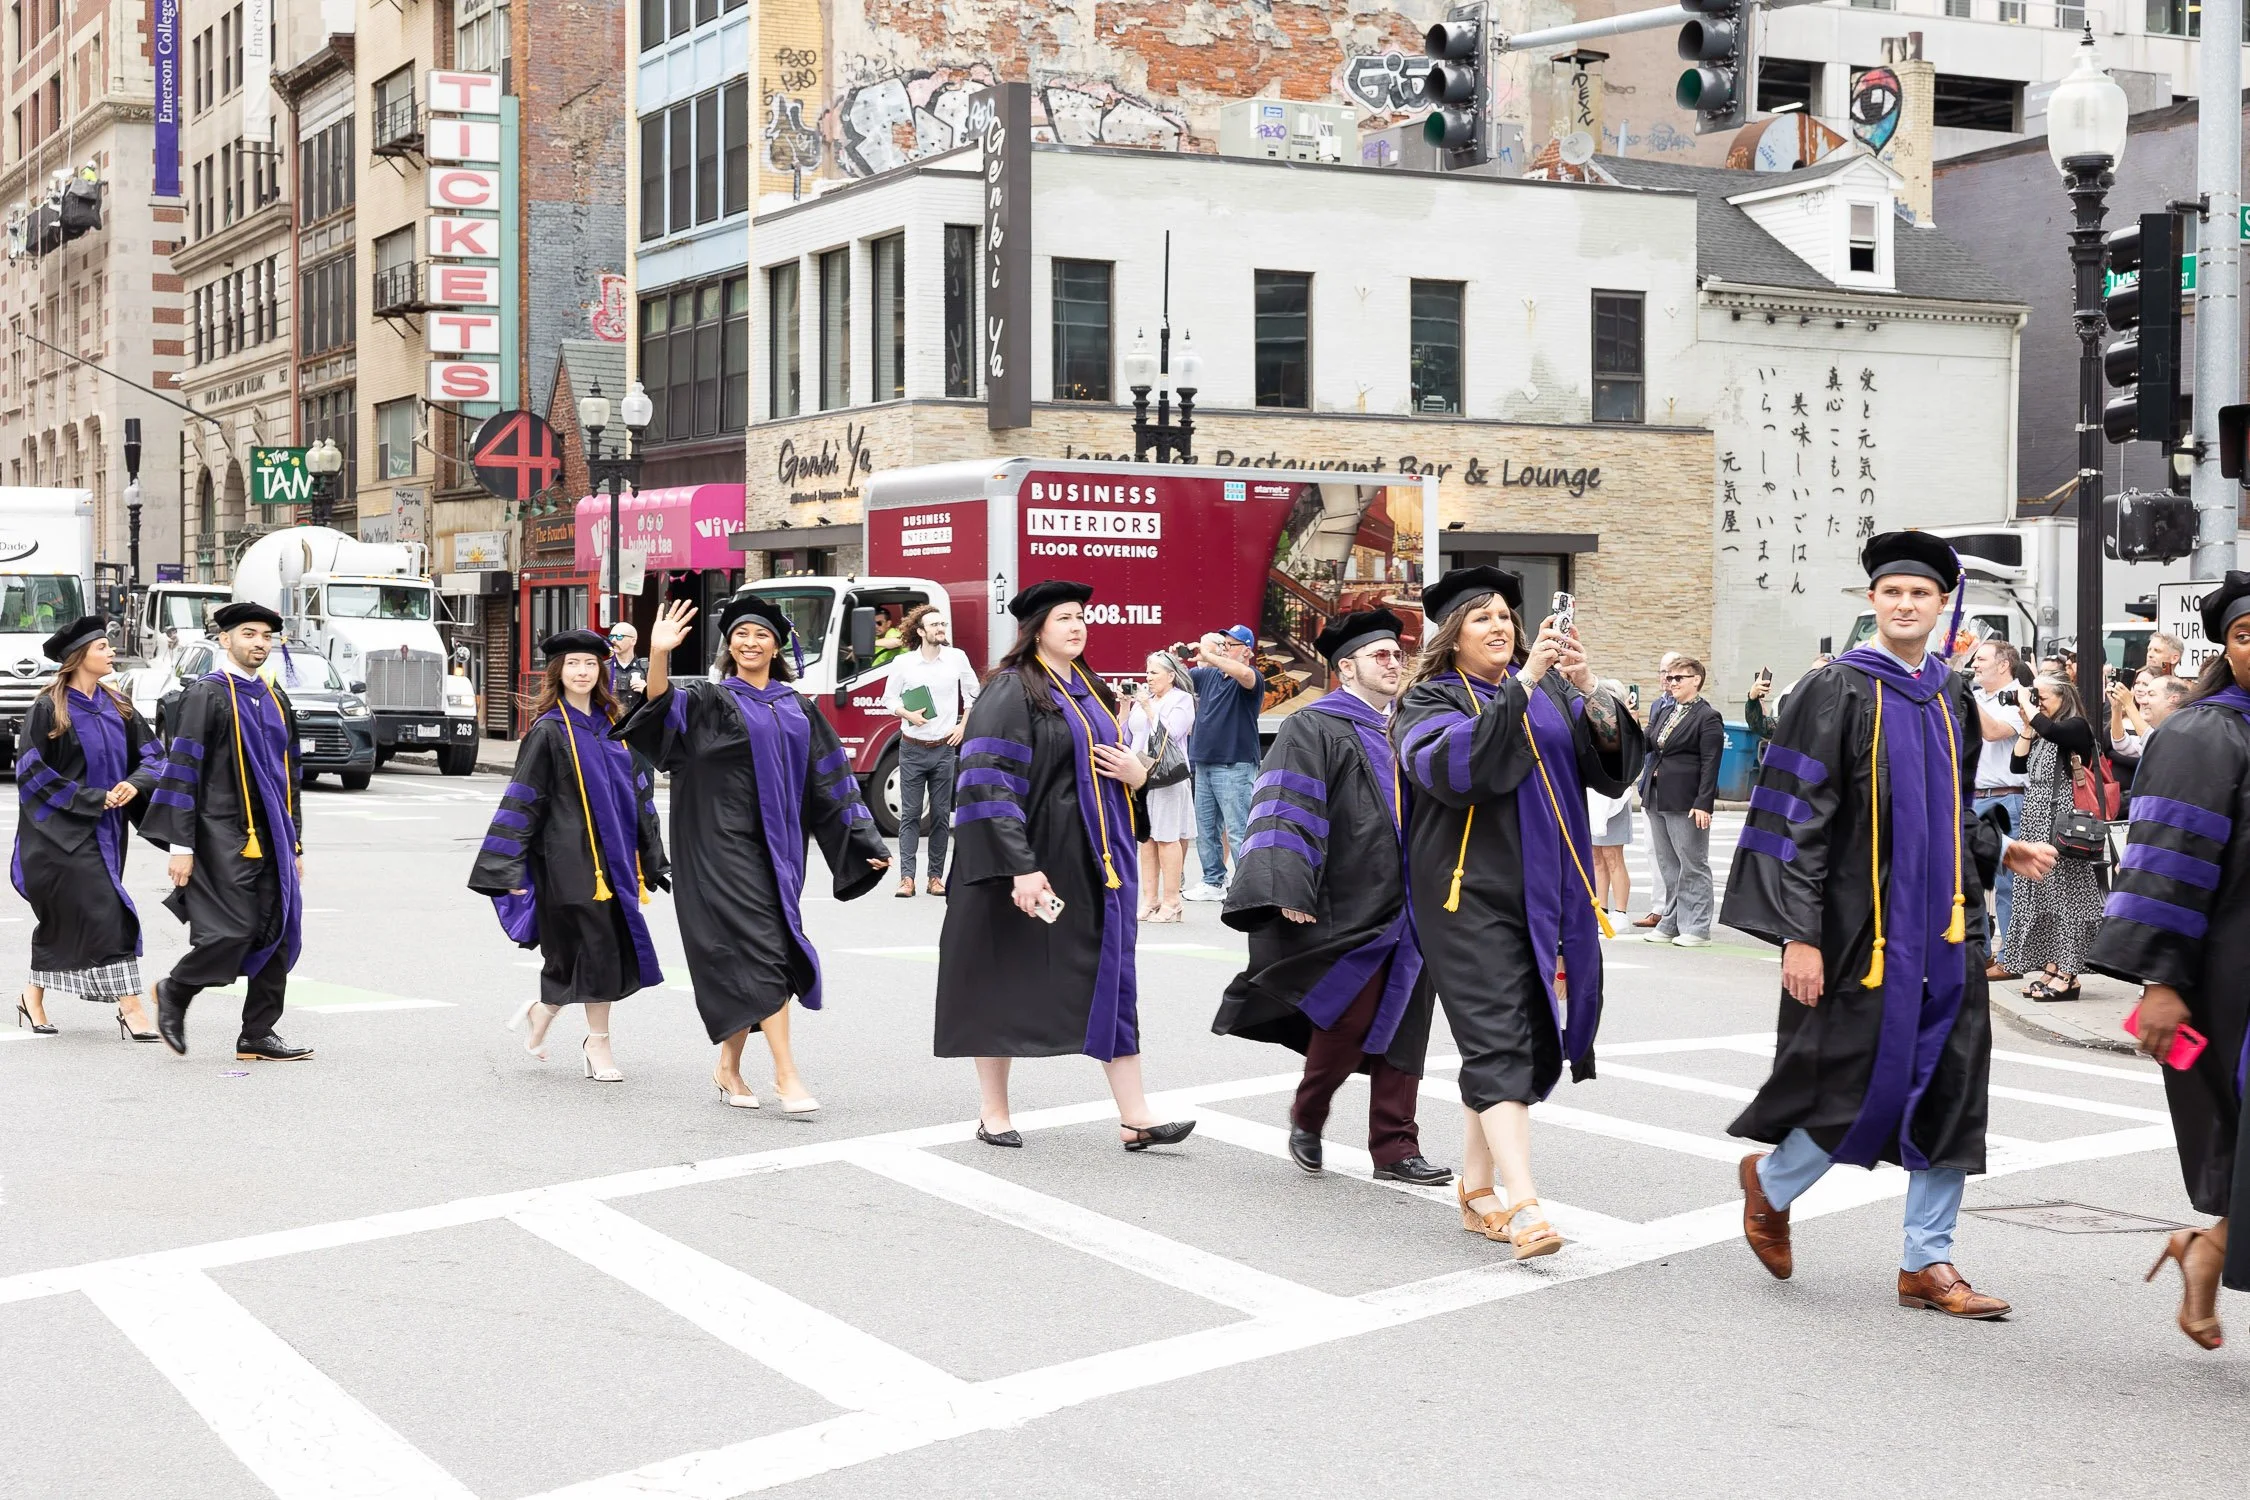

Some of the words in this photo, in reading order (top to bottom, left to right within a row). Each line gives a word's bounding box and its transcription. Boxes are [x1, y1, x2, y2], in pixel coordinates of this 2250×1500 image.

[157, 0, 176, 54] College
[158, 60, 172, 123] Emerson
[986, 115, 1006, 288] Genki
[438, 74, 492, 398] TICKETS
[988, 315, 1004, 378] Ya
[268, 450, 290, 465] The
[778, 438, 840, 488] Genki
[847, 422, 872, 487] Ya
[1464, 457, 1489, 486] &
[1502, 459, 1602, 498] Lounge
[1031, 482, 1157, 505] BUSINESS
[902, 512, 951, 527] BUSINESS
[1032, 514, 1156, 534] INTERIORS
[535, 527, 547, 544] The
[658, 534, 673, 554] tea
[1030, 542, 1078, 557] FLOOR
[1083, 543, 1159, 559] COVERING
[2180, 594, 2203, 613] NO
[2173, 621, 2205, 640] TUR
[456, 723, 473, 736] 263
